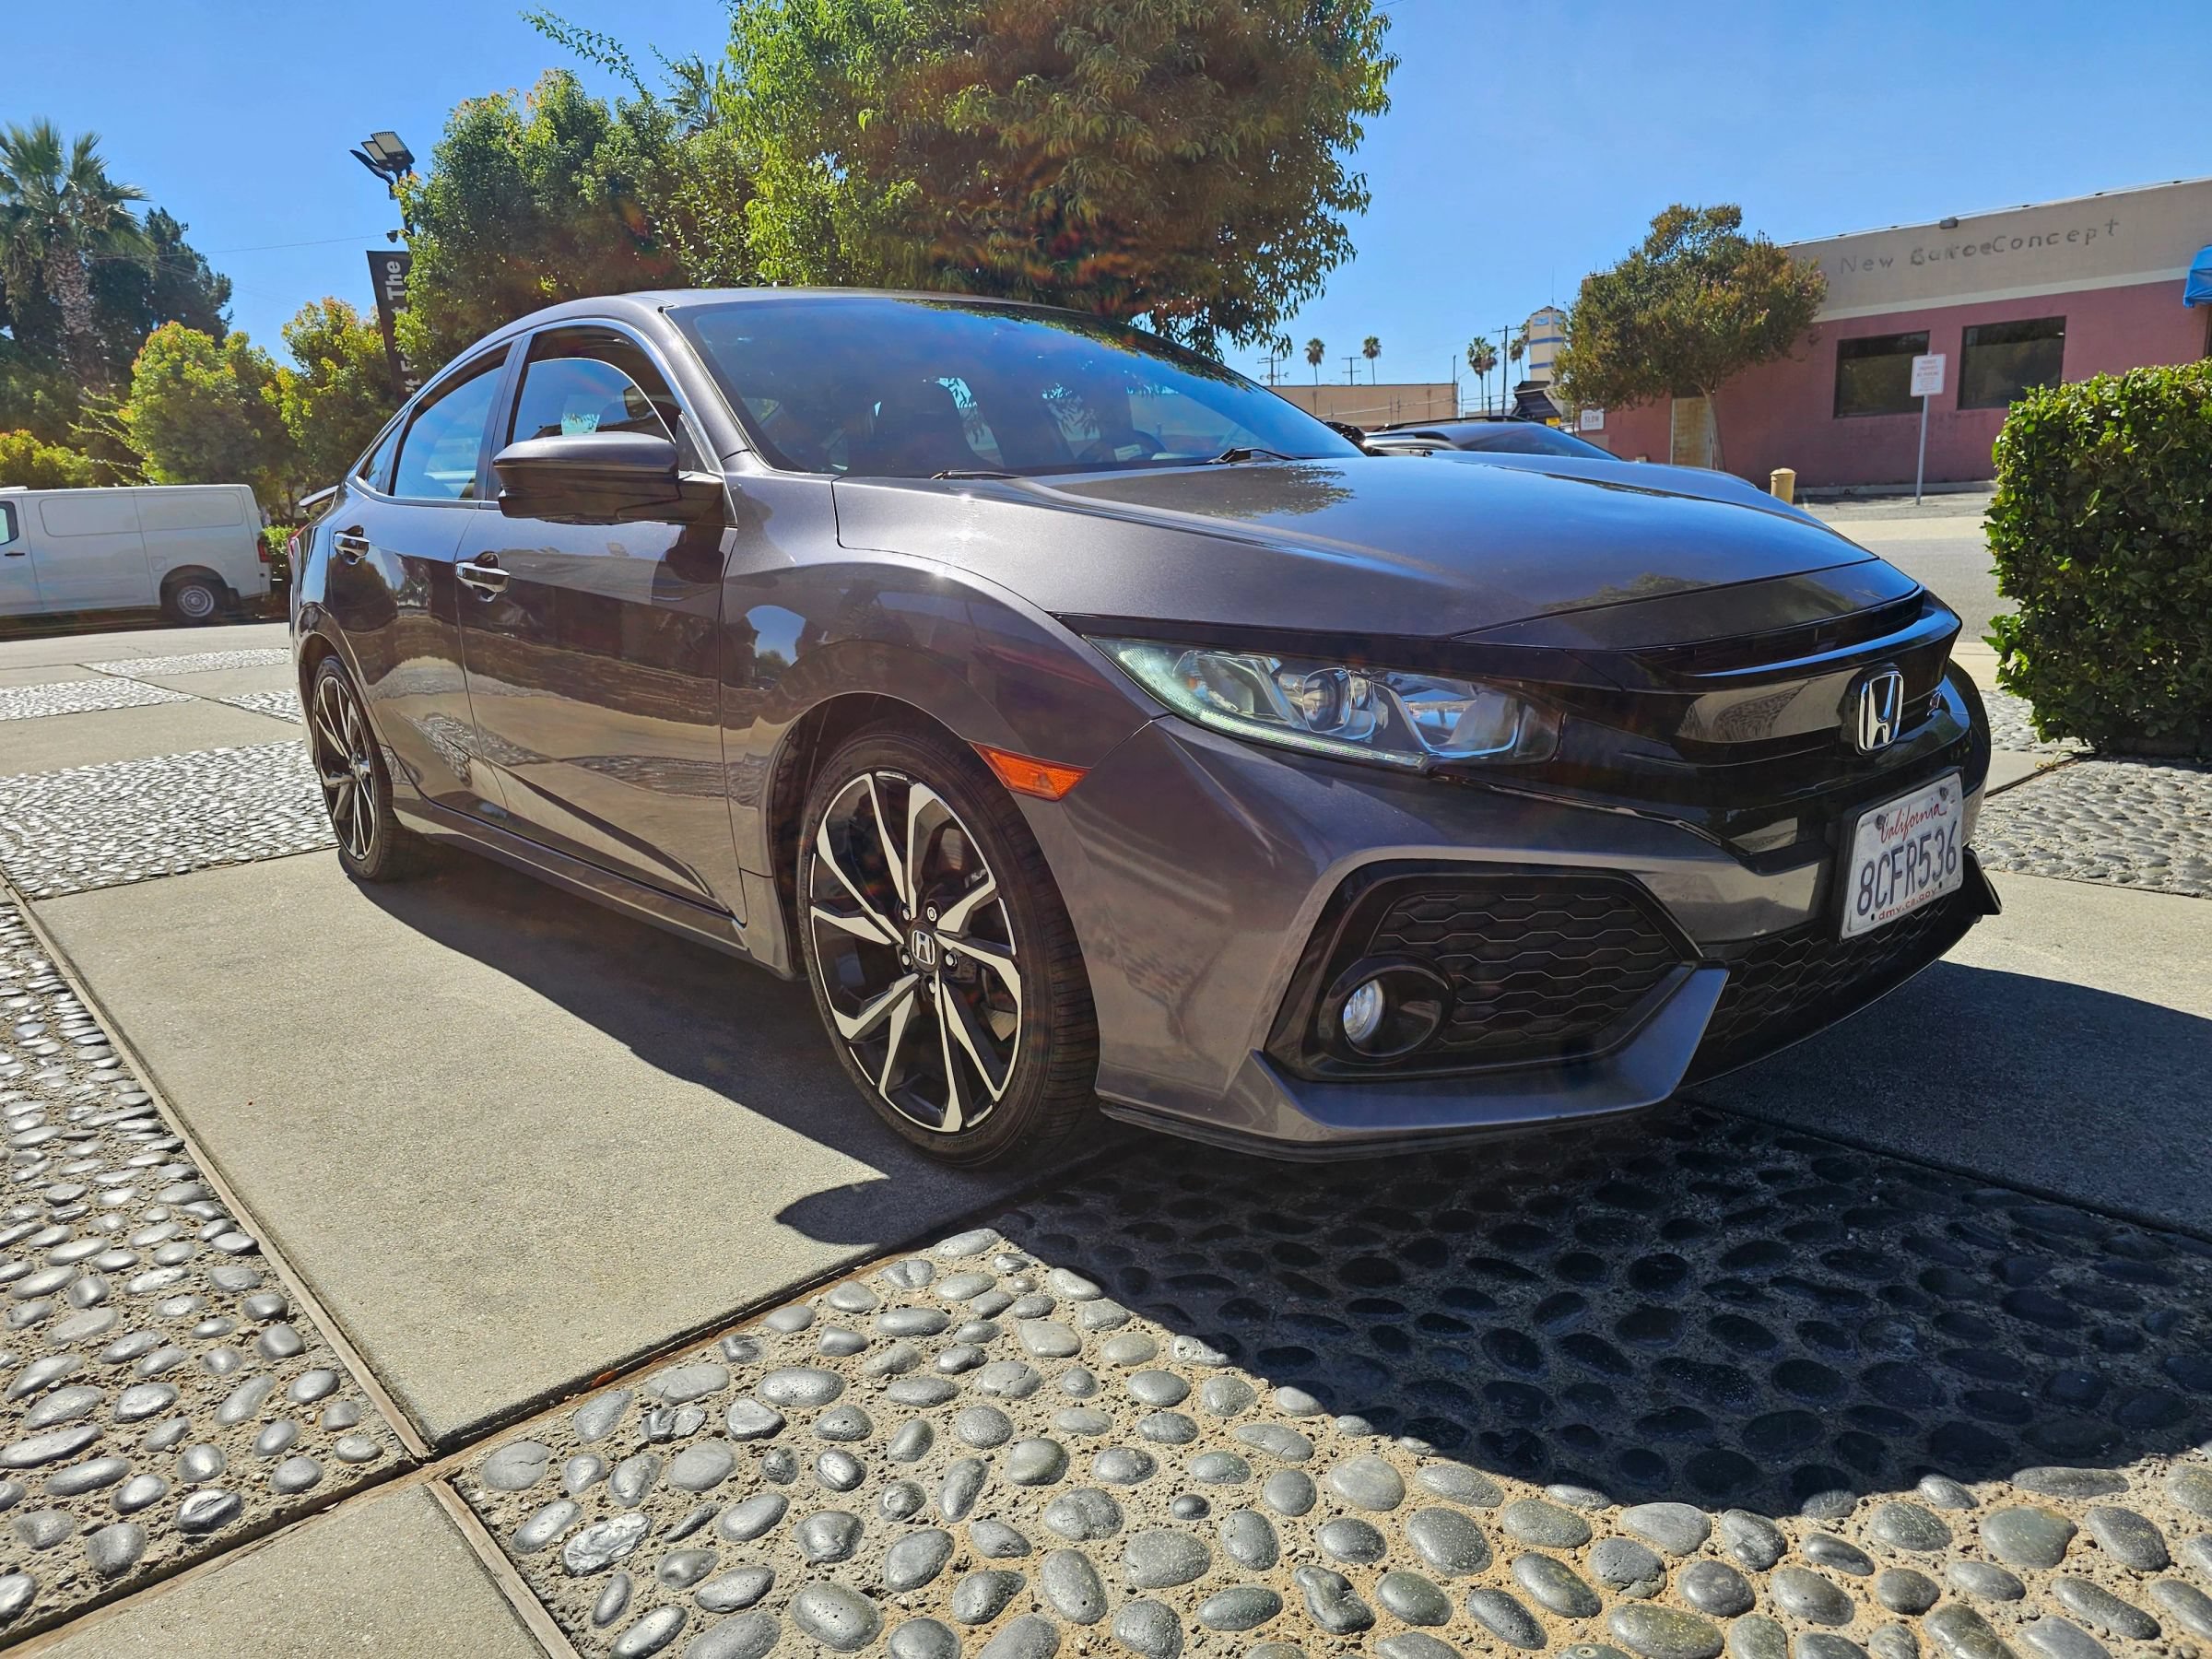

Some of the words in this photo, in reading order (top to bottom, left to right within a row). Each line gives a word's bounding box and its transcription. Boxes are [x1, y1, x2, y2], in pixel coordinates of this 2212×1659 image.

[385, 261, 406, 300] The
[1841, 257, 1893, 274] New
[1879, 797, 1947, 843] California
[1856, 819, 1958, 916] 8CFR536
[1878, 888, 1937, 921] dmv.ca.gov
